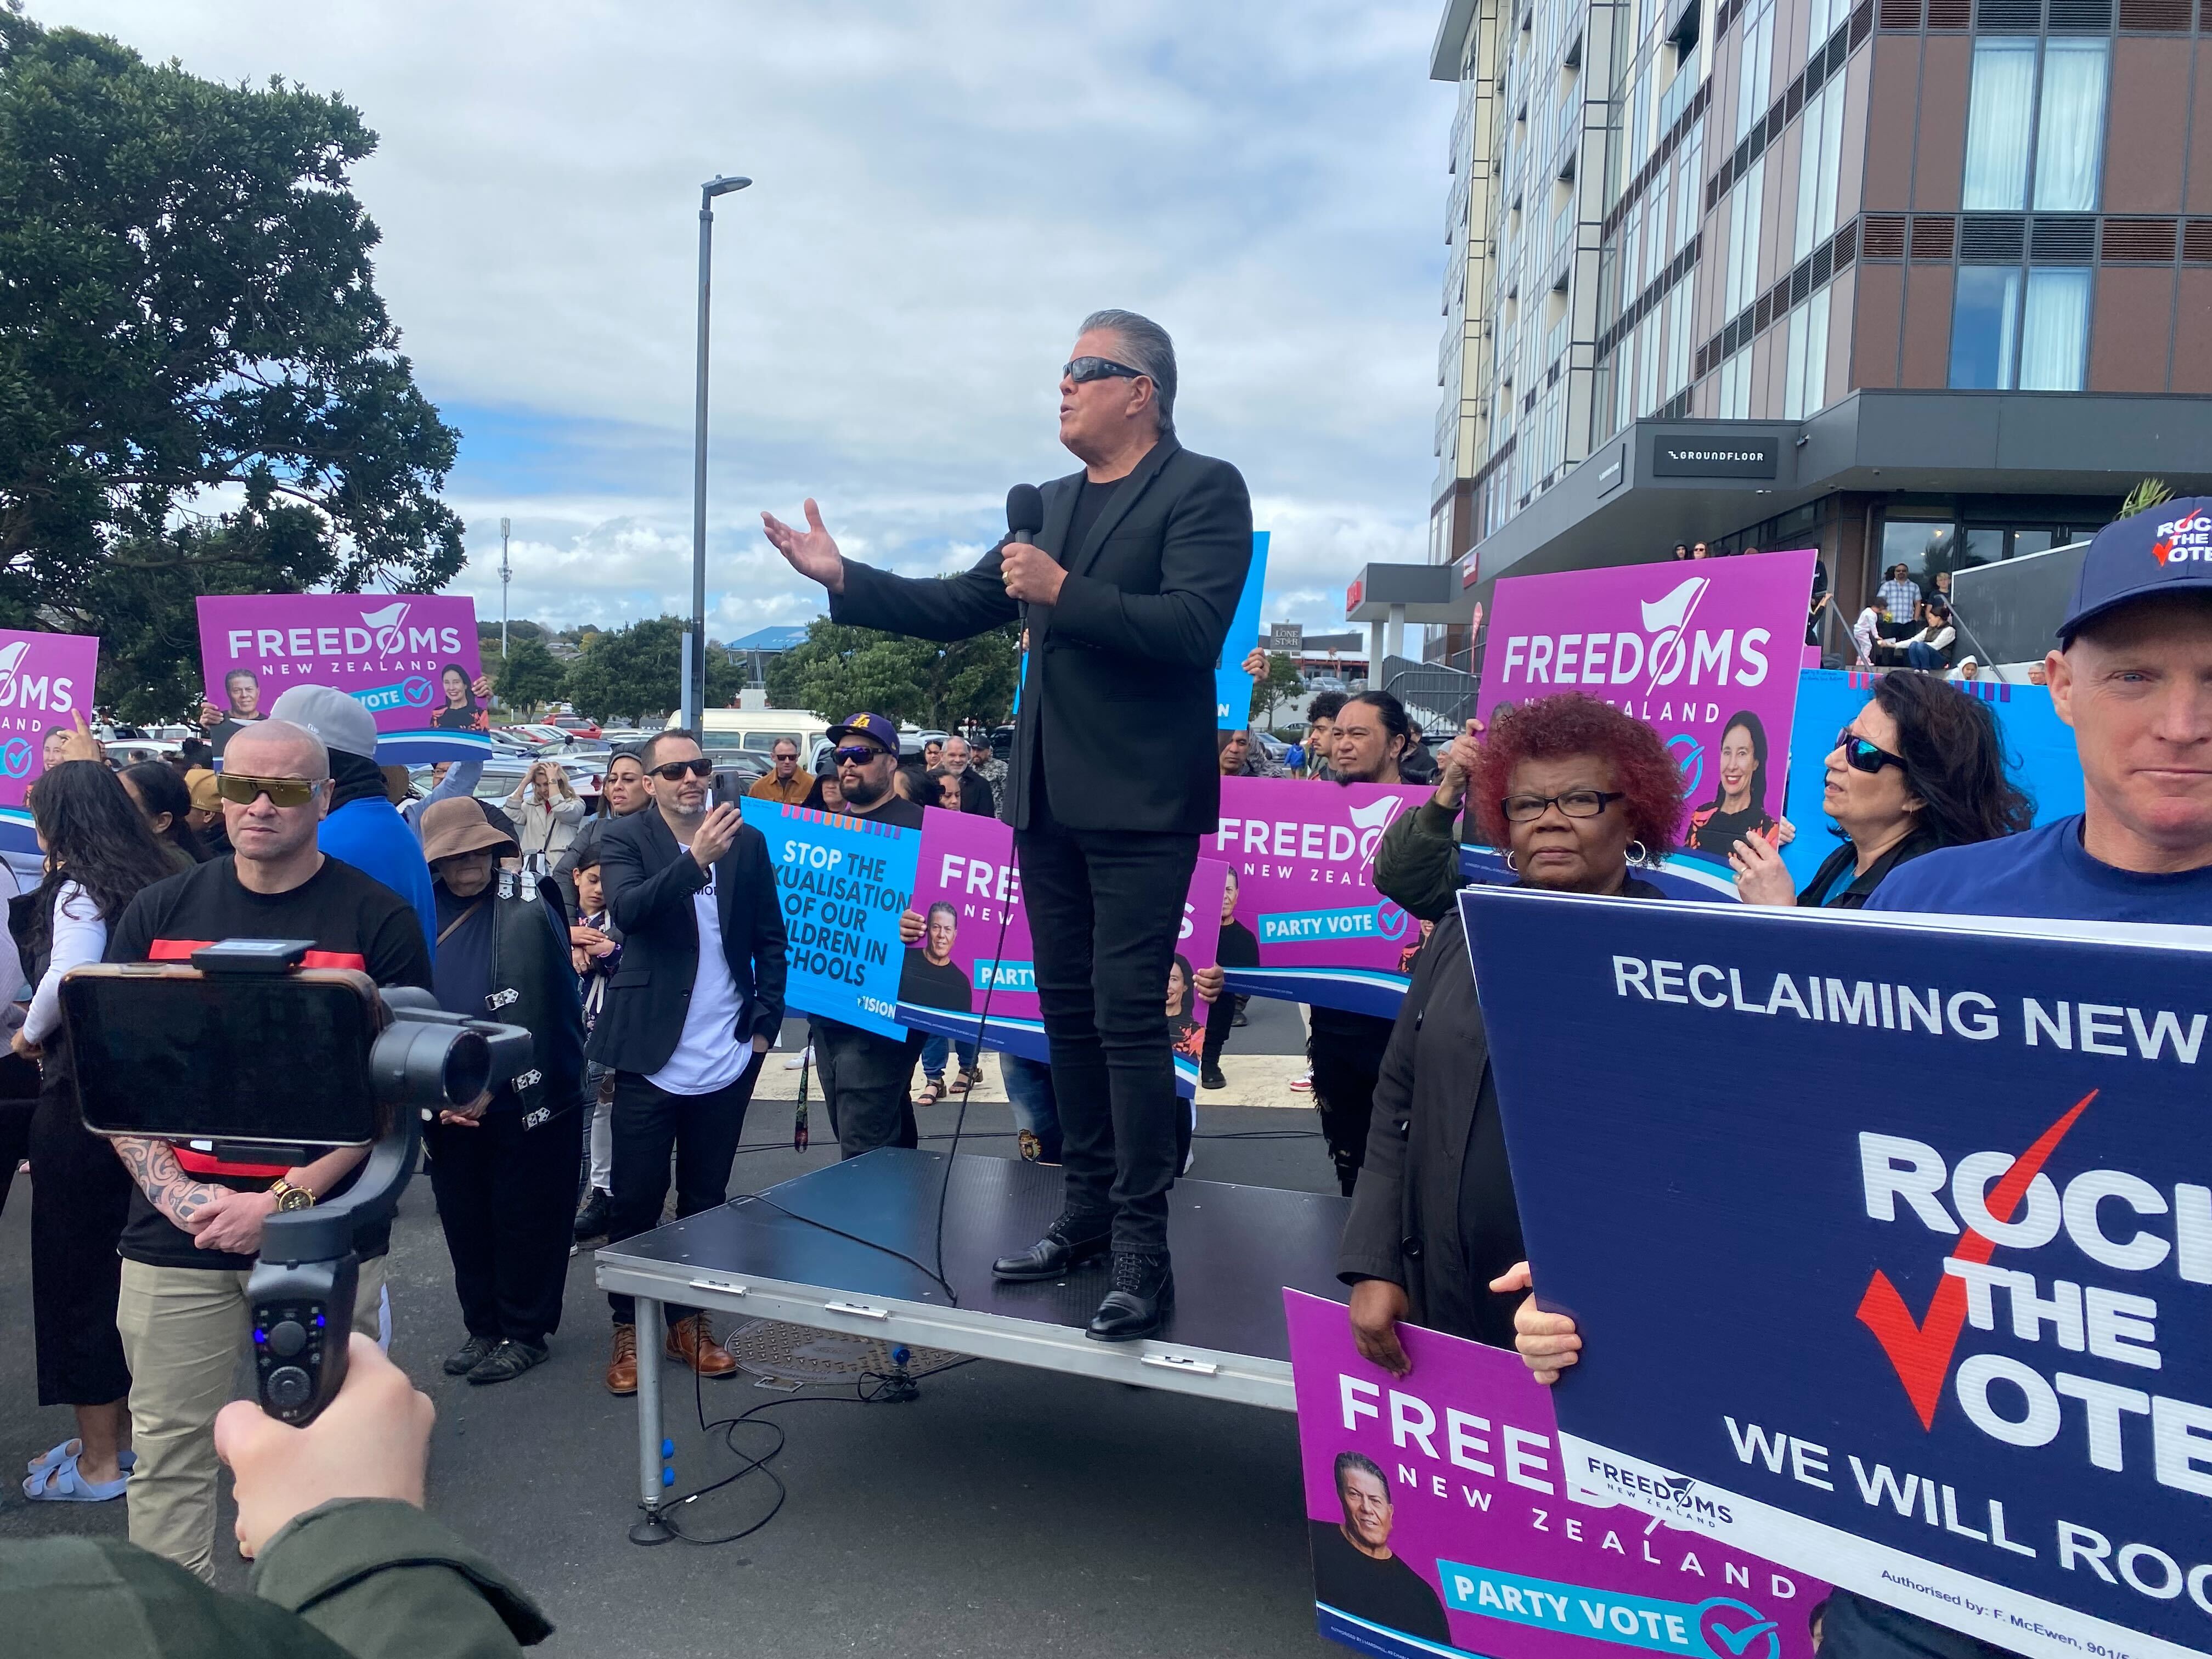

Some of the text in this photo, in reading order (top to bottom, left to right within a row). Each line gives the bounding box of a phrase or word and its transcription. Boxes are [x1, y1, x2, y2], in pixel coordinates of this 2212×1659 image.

[1680, 452, 1764, 461] GROUNDFLOOR
[2157, 517, 2212, 537] ROC
[2169, 533, 2209, 546] THE
[228, 627, 461, 658] FREEDOMS
[1503, 628, 1771, 687] FREEDOMS
[263, 661, 437, 675] NEW ZEALAND
[783, 840, 887, 883] STOP THE
[1244, 863, 1293, 879] NEW
[785, 893, 867, 933] OF OUR
[964, 904, 1014, 926] NEW
[1266, 913, 1373, 938] PARTY VOTE
[864, 939, 888, 966] IN
[1612, 955, 2208, 1064] RECLAIMING NEW
[1943, 1256, 2162, 1370] THE
[1588, 1457, 1734, 1524] FREEDOMS
[1607, 1483, 1715, 1528] NEW ZEALAND
[1724, 1415, 1834, 1492] WE
[1848, 1454, 2036, 1558] WILL
[1398, 1463, 1796, 1601] NEW ZEALAND
[1453, 1574, 1690, 1646] PARTY VOTE
[1882, 1570, 1961, 1606] Authorised
[1966, 1598, 1989, 1615] by:
[1994, 1609, 2006, 1622] F.
[2011, 1614, 2082, 1650] McEwen,
[1330, 1626, 1356, 1640] AUTHORISED
